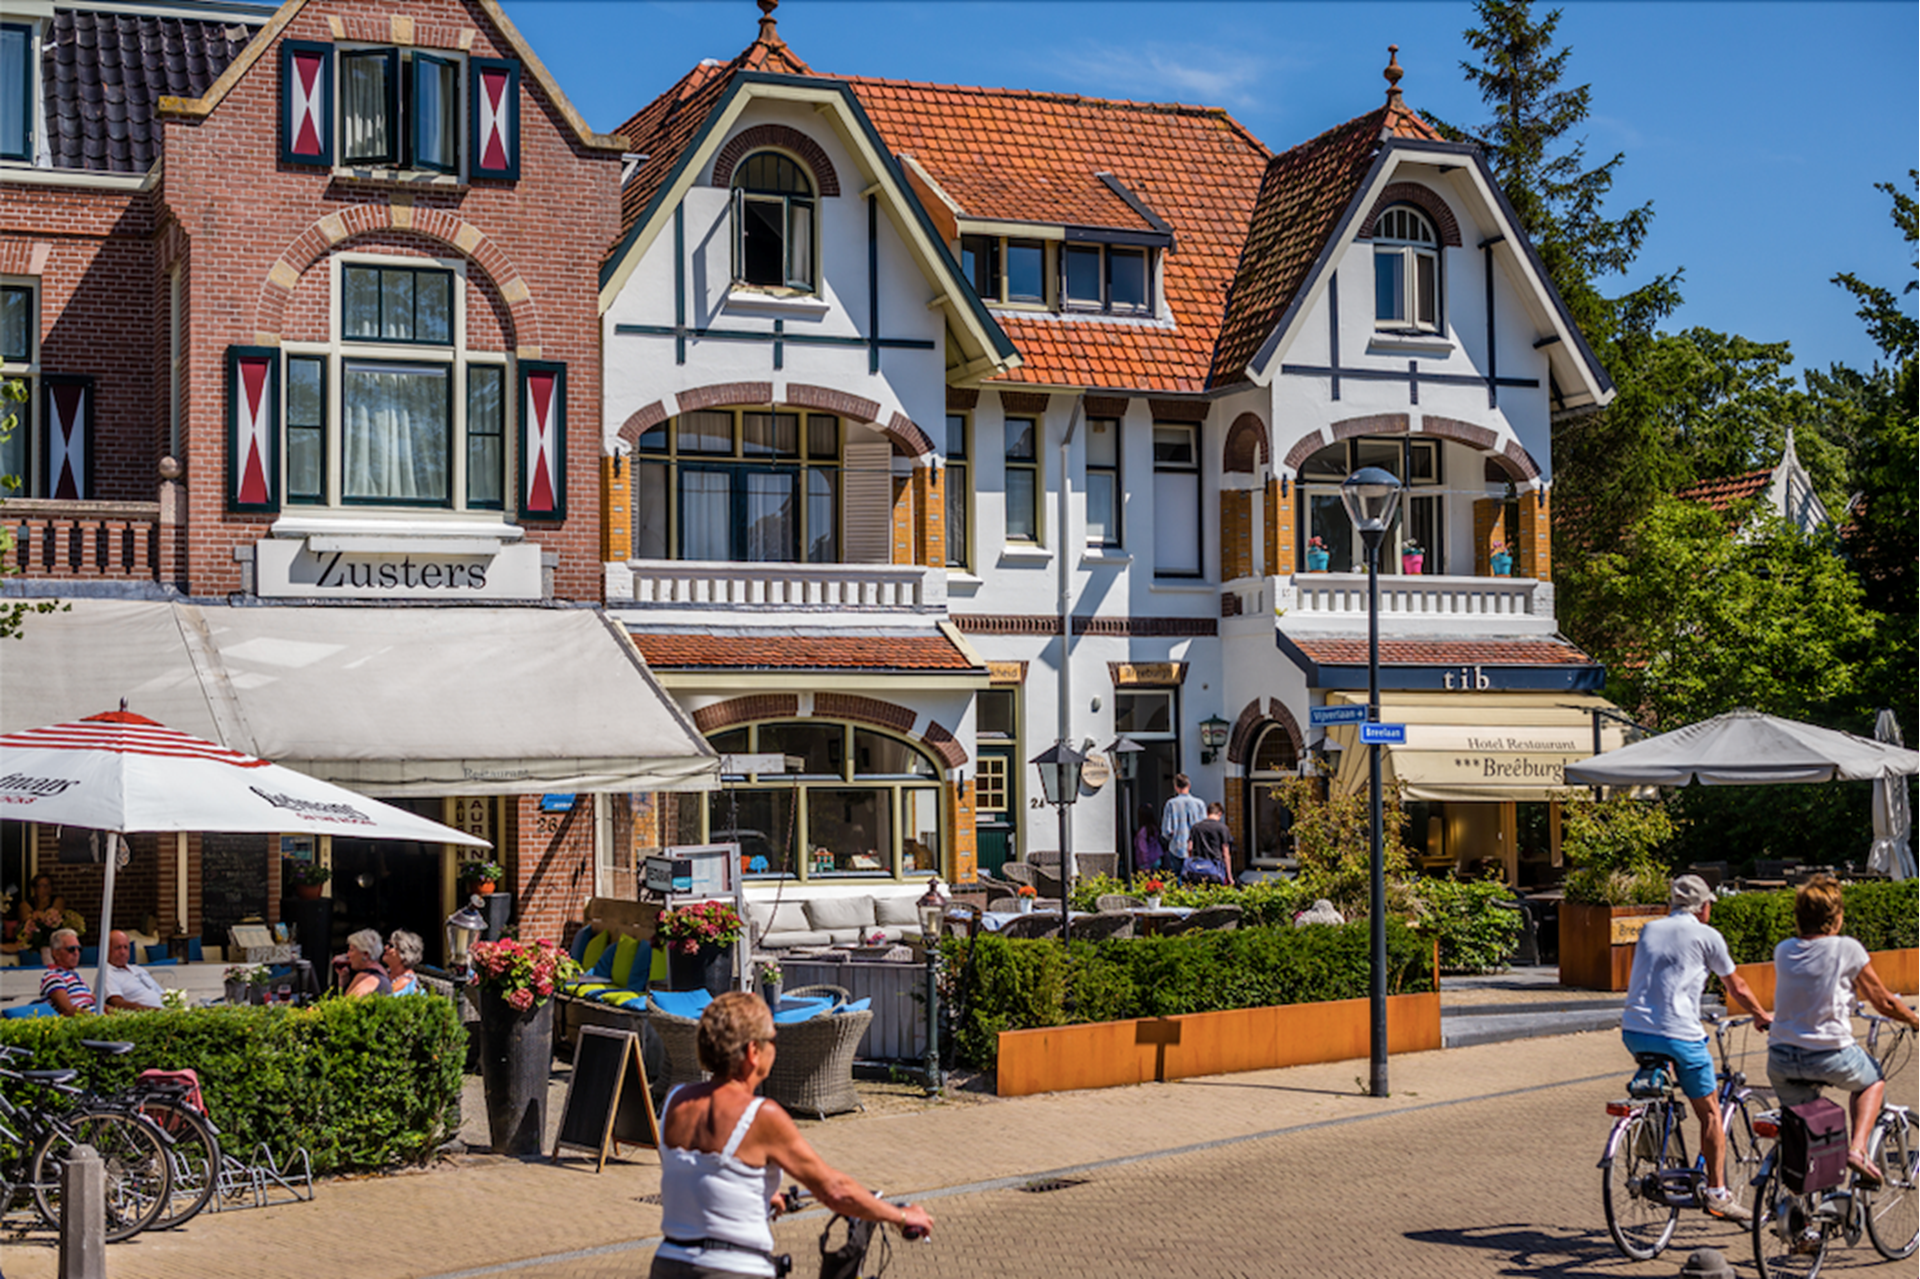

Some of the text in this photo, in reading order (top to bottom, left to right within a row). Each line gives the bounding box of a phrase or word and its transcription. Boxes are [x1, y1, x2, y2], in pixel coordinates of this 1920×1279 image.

[316, 552, 488, 589] Zusters
[1443, 665, 1491, 691] tib
[1313, 709, 1356, 723] Vijverlaan
[1366, 726, 1401, 738] Breelaan
[1467, 738, 1577, 751] Hotel Restaurant
[463, 767, 529, 779] Restaurant
[537, 816, 558, 833] 26
